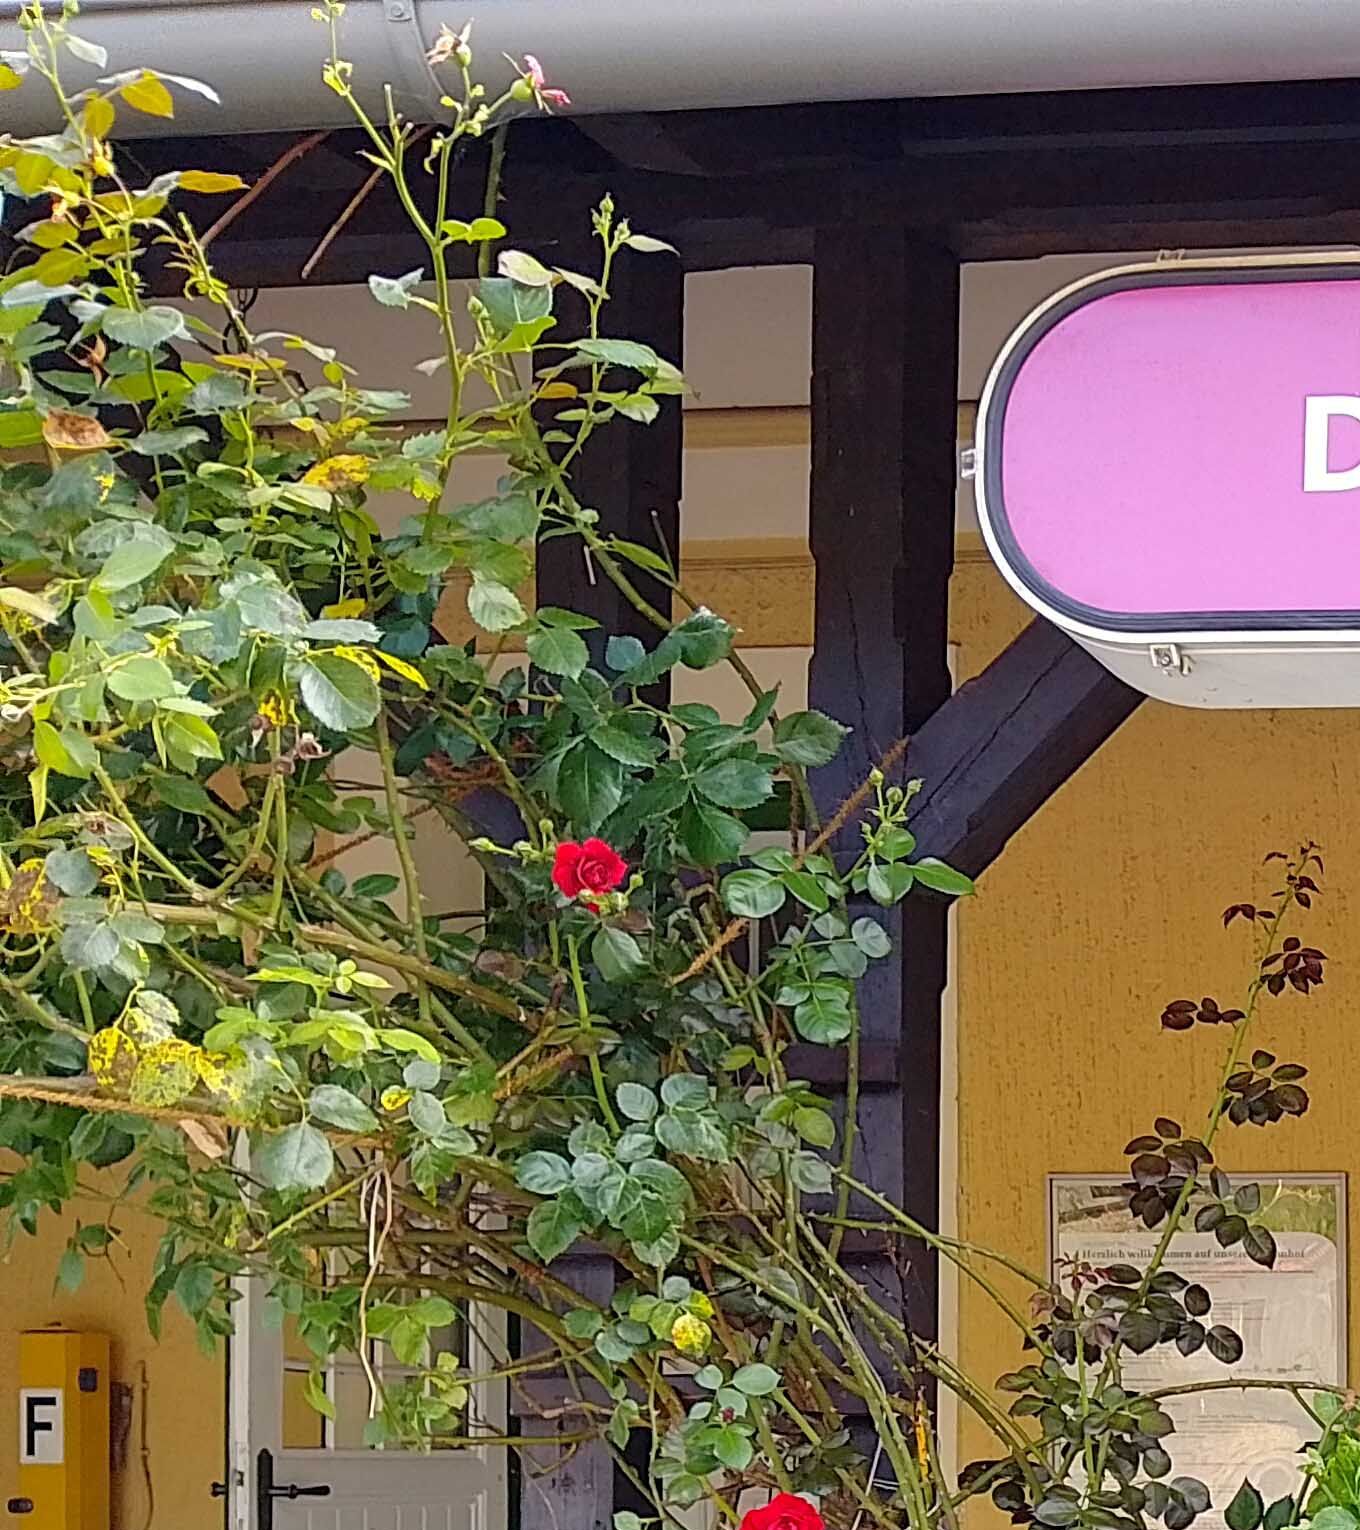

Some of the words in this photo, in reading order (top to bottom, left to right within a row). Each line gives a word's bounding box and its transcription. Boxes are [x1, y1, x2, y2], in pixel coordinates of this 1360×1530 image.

[1082, 1249, 1125, 1259] Herzlich
[1194, 1249, 1211, 1259] auf
[27, 1397, 56, 1456] F
